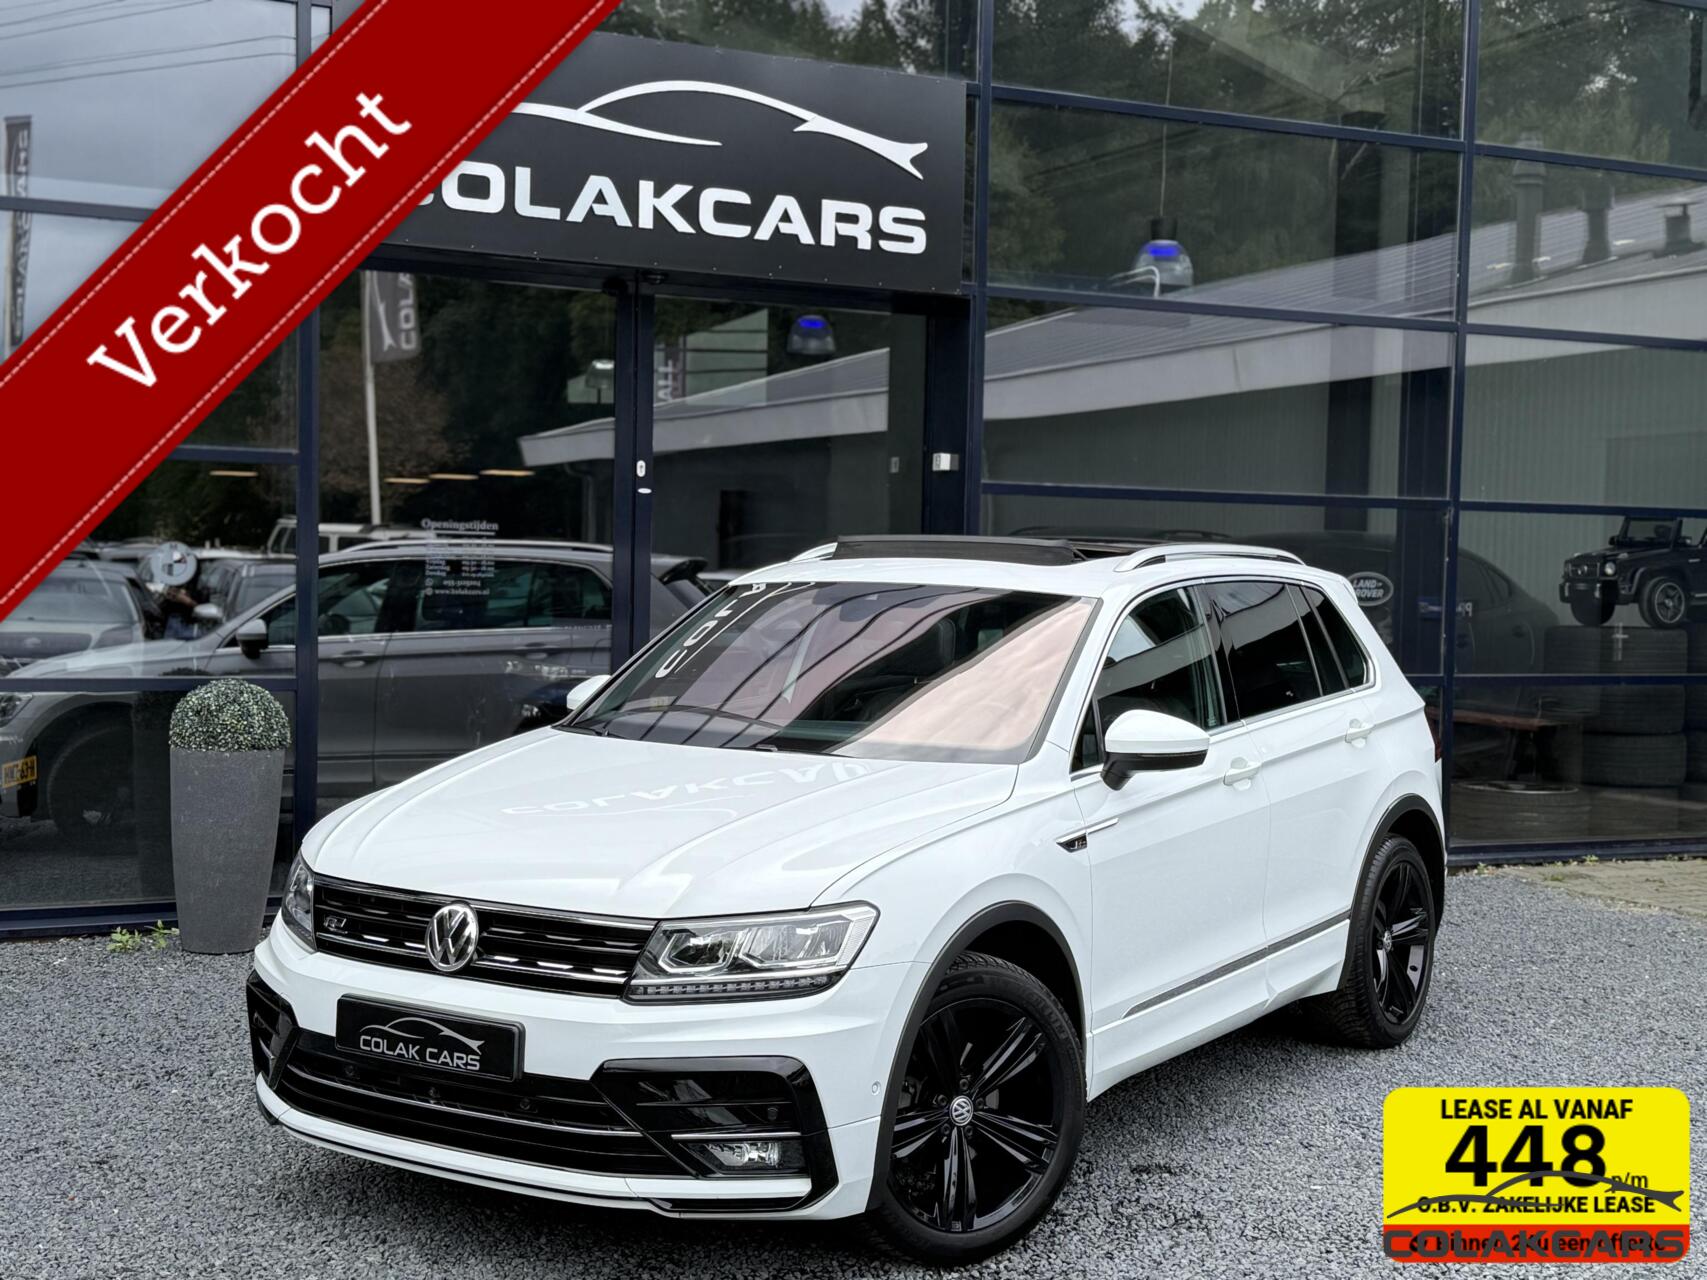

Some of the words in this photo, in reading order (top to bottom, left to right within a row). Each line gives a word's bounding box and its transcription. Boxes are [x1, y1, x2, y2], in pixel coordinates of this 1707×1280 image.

[416, 160, 928, 256] OLAKCARS
[420, 517, 499, 532] Openingstijden
[359, 1035, 421, 1061] COLAK
[425, 1047, 481, 1071] CARS
